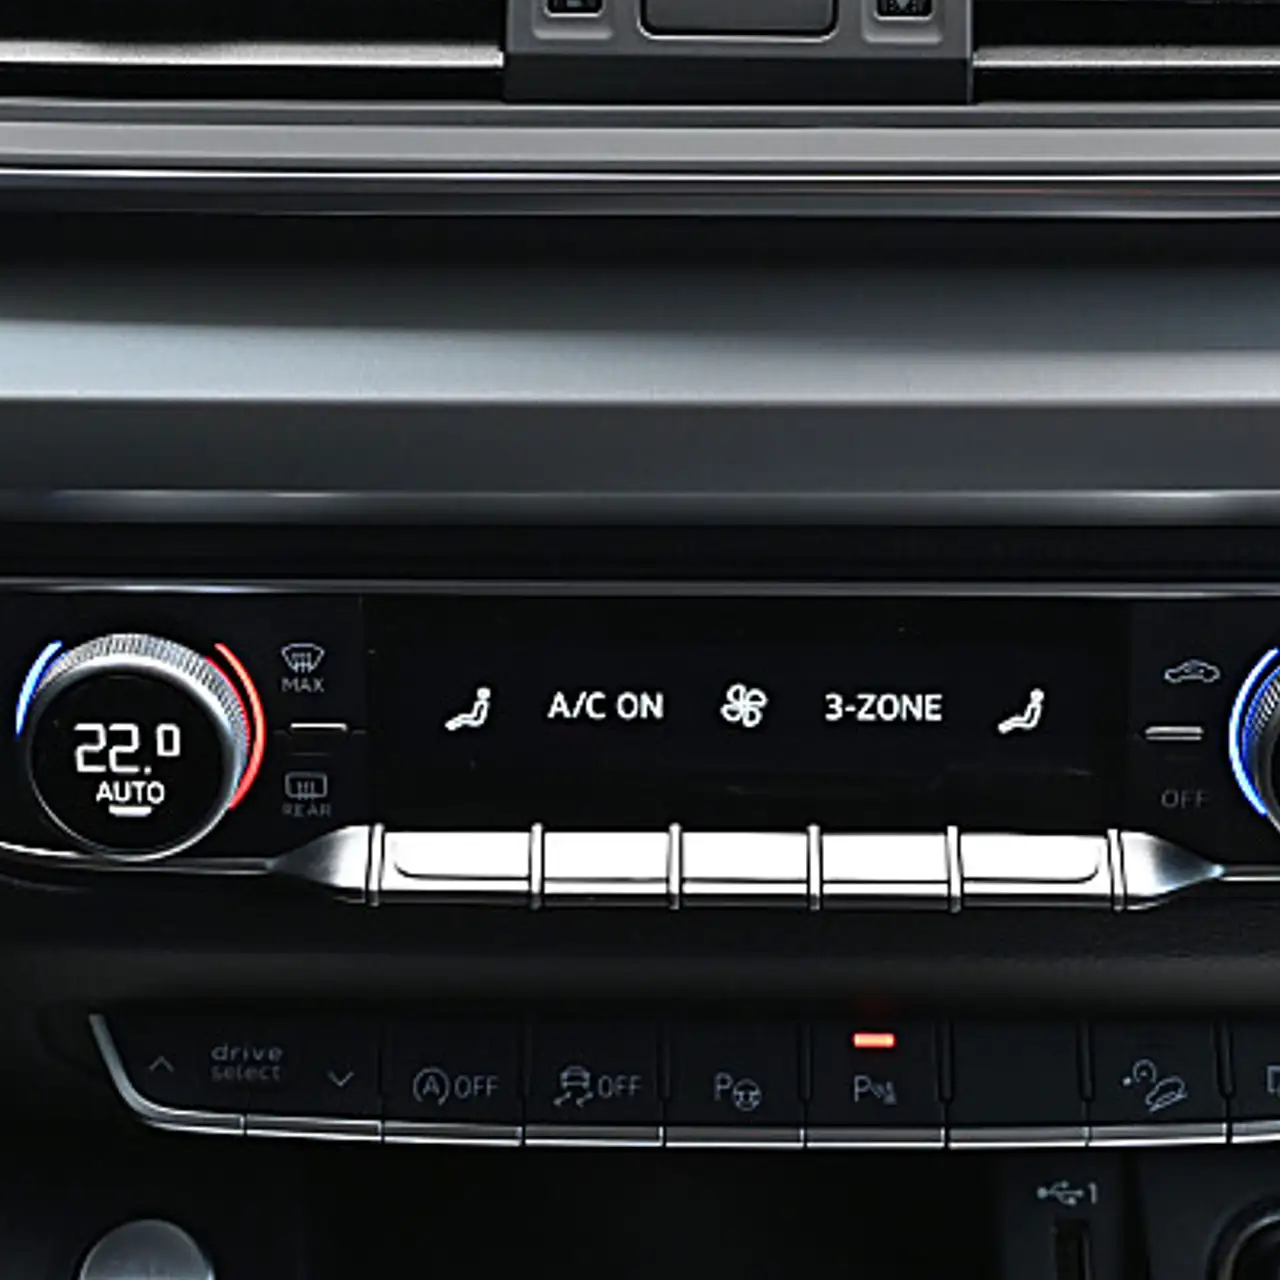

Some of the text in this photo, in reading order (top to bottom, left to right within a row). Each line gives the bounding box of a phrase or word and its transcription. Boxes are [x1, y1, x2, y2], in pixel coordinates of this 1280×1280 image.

[281, 676, 325, 694] MAX
[547, 690, 664, 720] A/C ON
[824, 692, 943, 722] 3-ZONE
[95, 779, 166, 806] AUTO
[1161, 789, 1209, 809] OFF
[281, 803, 332, 818] REAR
[211, 1042, 283, 1063] drive
[211, 1064, 282, 1083] select
[454, 1075, 498, 1098] OFF
[597, 1075, 641, 1098] OFF
